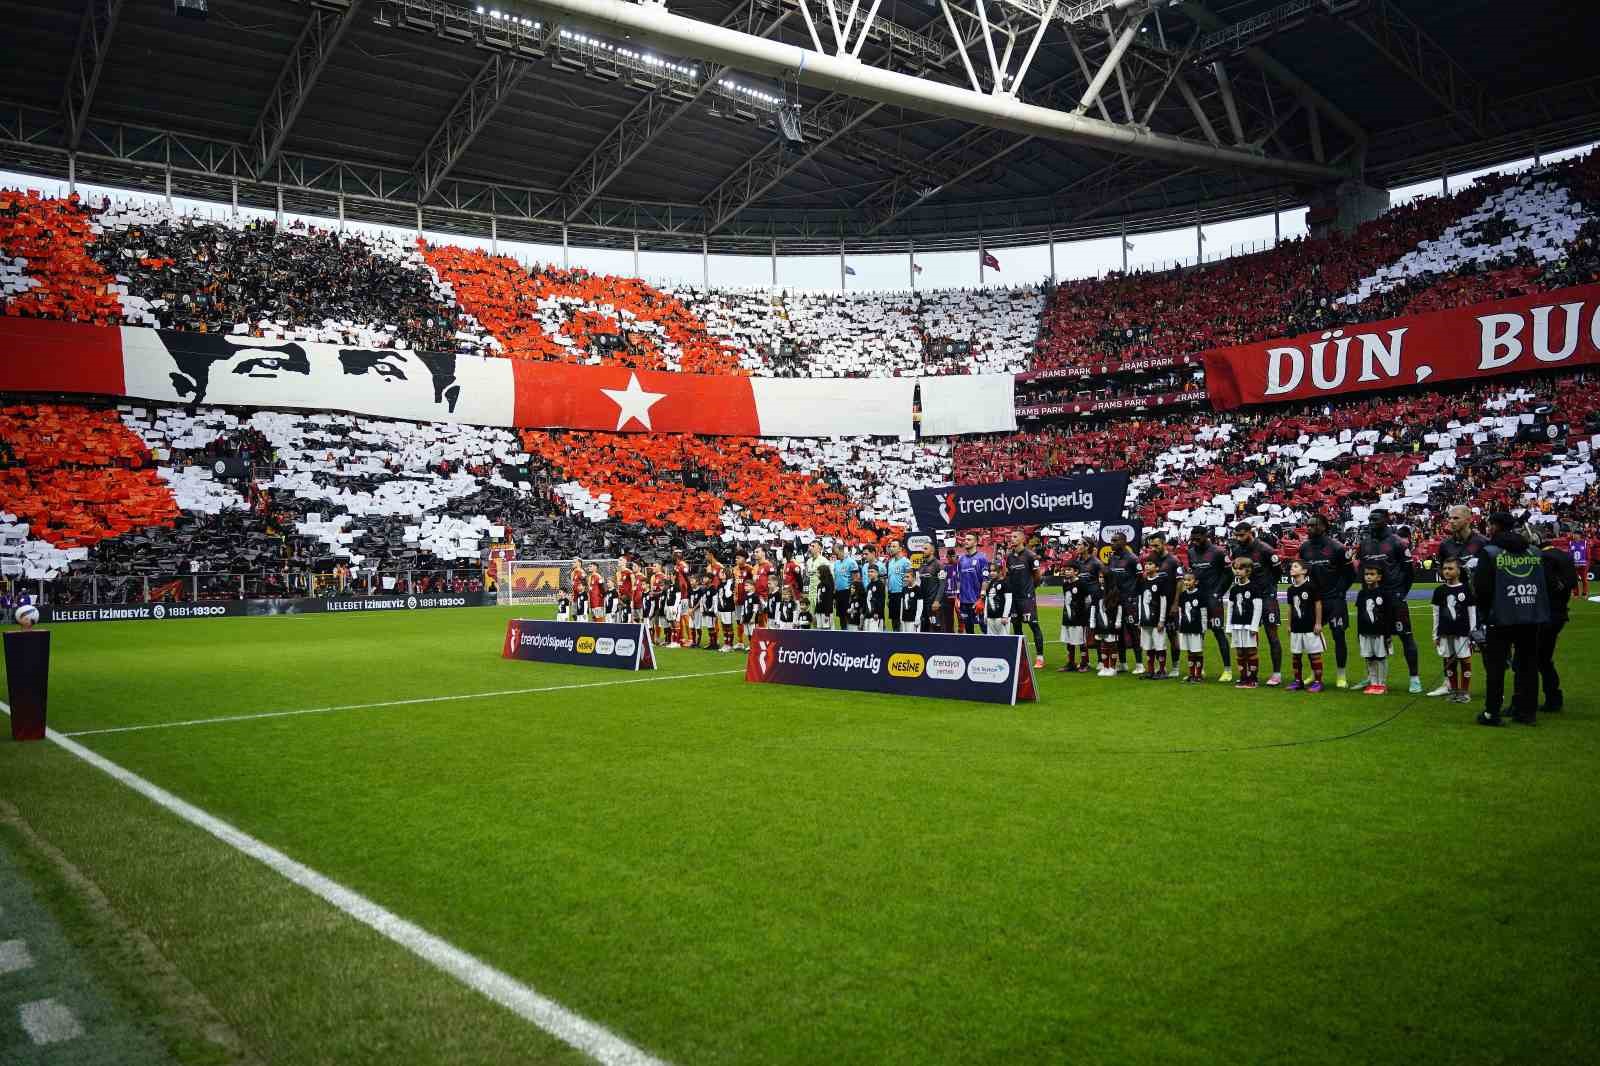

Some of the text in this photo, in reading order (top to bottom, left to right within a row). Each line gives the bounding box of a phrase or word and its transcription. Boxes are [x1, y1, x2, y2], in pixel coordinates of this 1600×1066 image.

[1264, 301, 1600, 396] DÜN, BU
[1125, 357, 1174, 370] RAMS PARK
[1042, 367, 1091, 378] RAMS PARK
[1181, 392, 1205, 401] RAMS
[1098, 398, 1148, 409] RAMS PARK
[1016, 406, 1064, 417] RAMS PARK
[958, 490, 1029, 515] trendyol
[777, 646, 833, 669] trendyol
